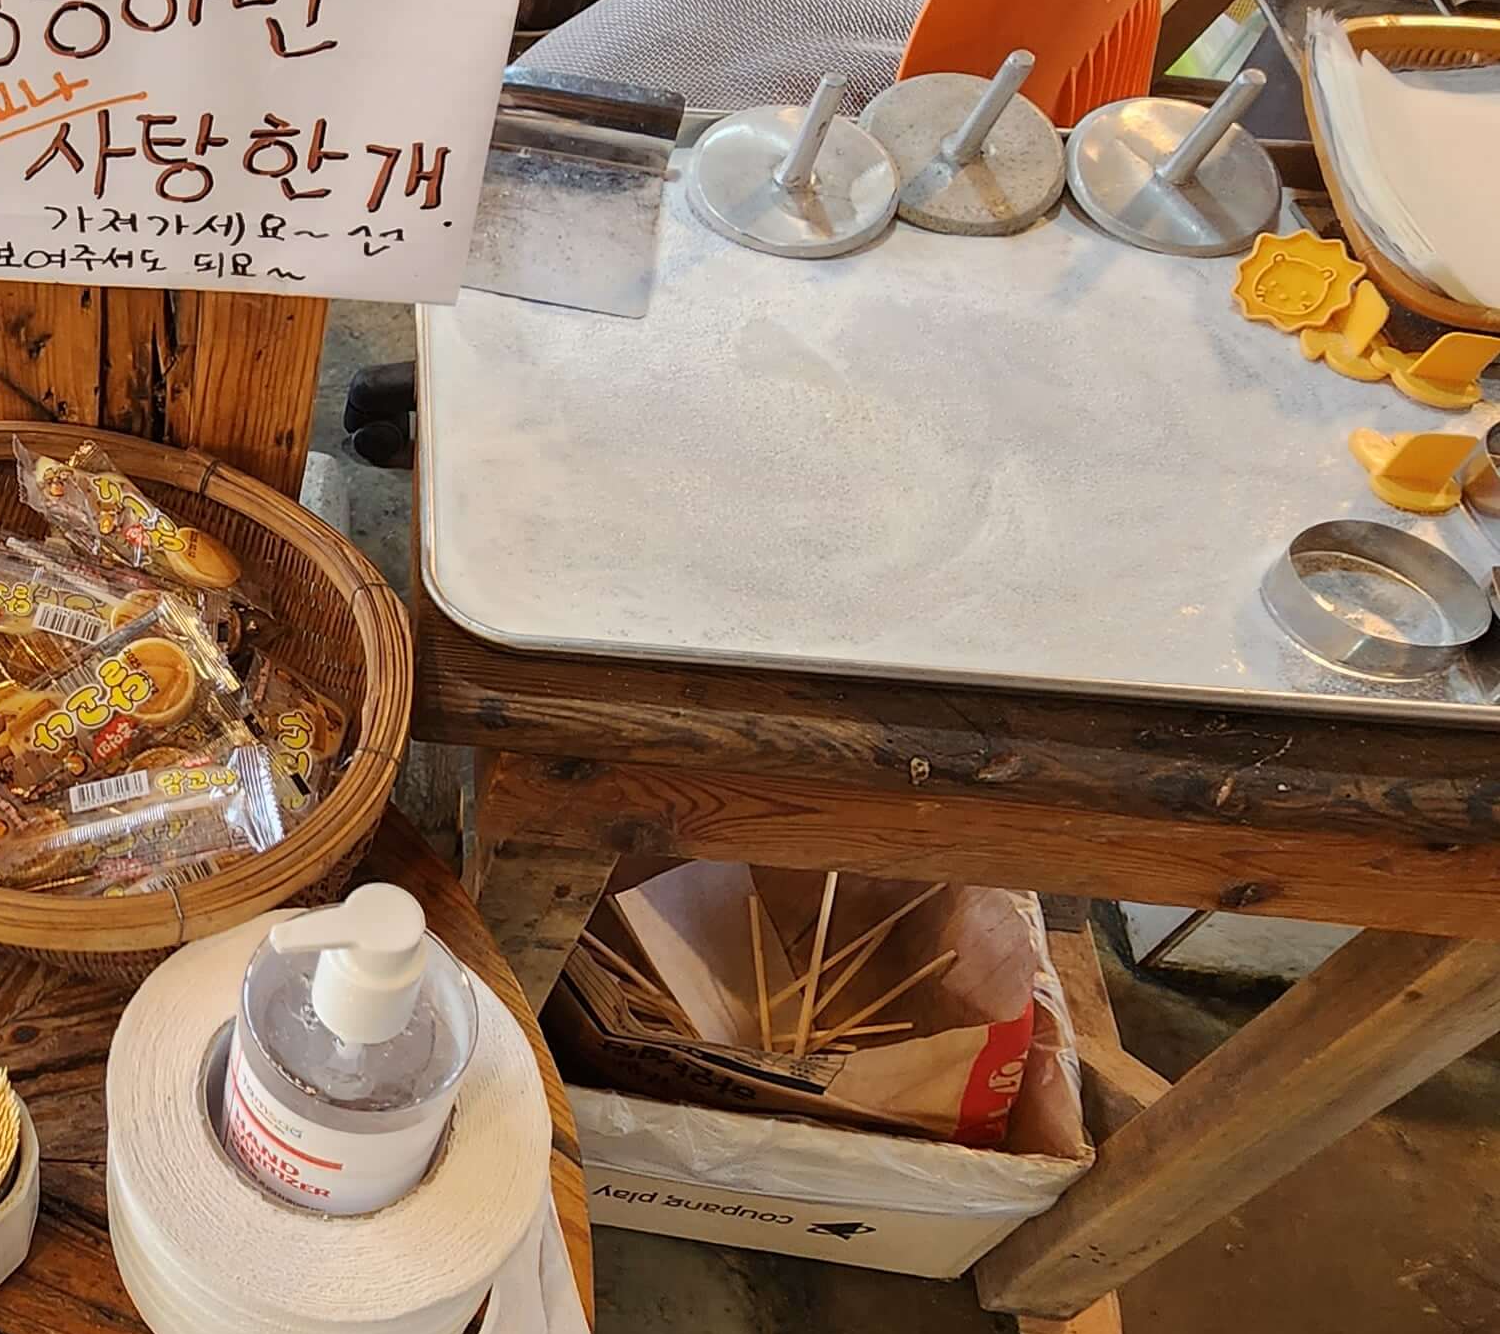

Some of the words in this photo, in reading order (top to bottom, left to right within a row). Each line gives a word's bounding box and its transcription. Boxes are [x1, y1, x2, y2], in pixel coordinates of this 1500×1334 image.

[32, 658, 152, 752] 달고나
[94, 717, 137, 761] 추억의
[155, 768, 240, 797] 달고나
[591, 1180, 661, 1208] play
[662, 1192, 798, 1229] coupang
